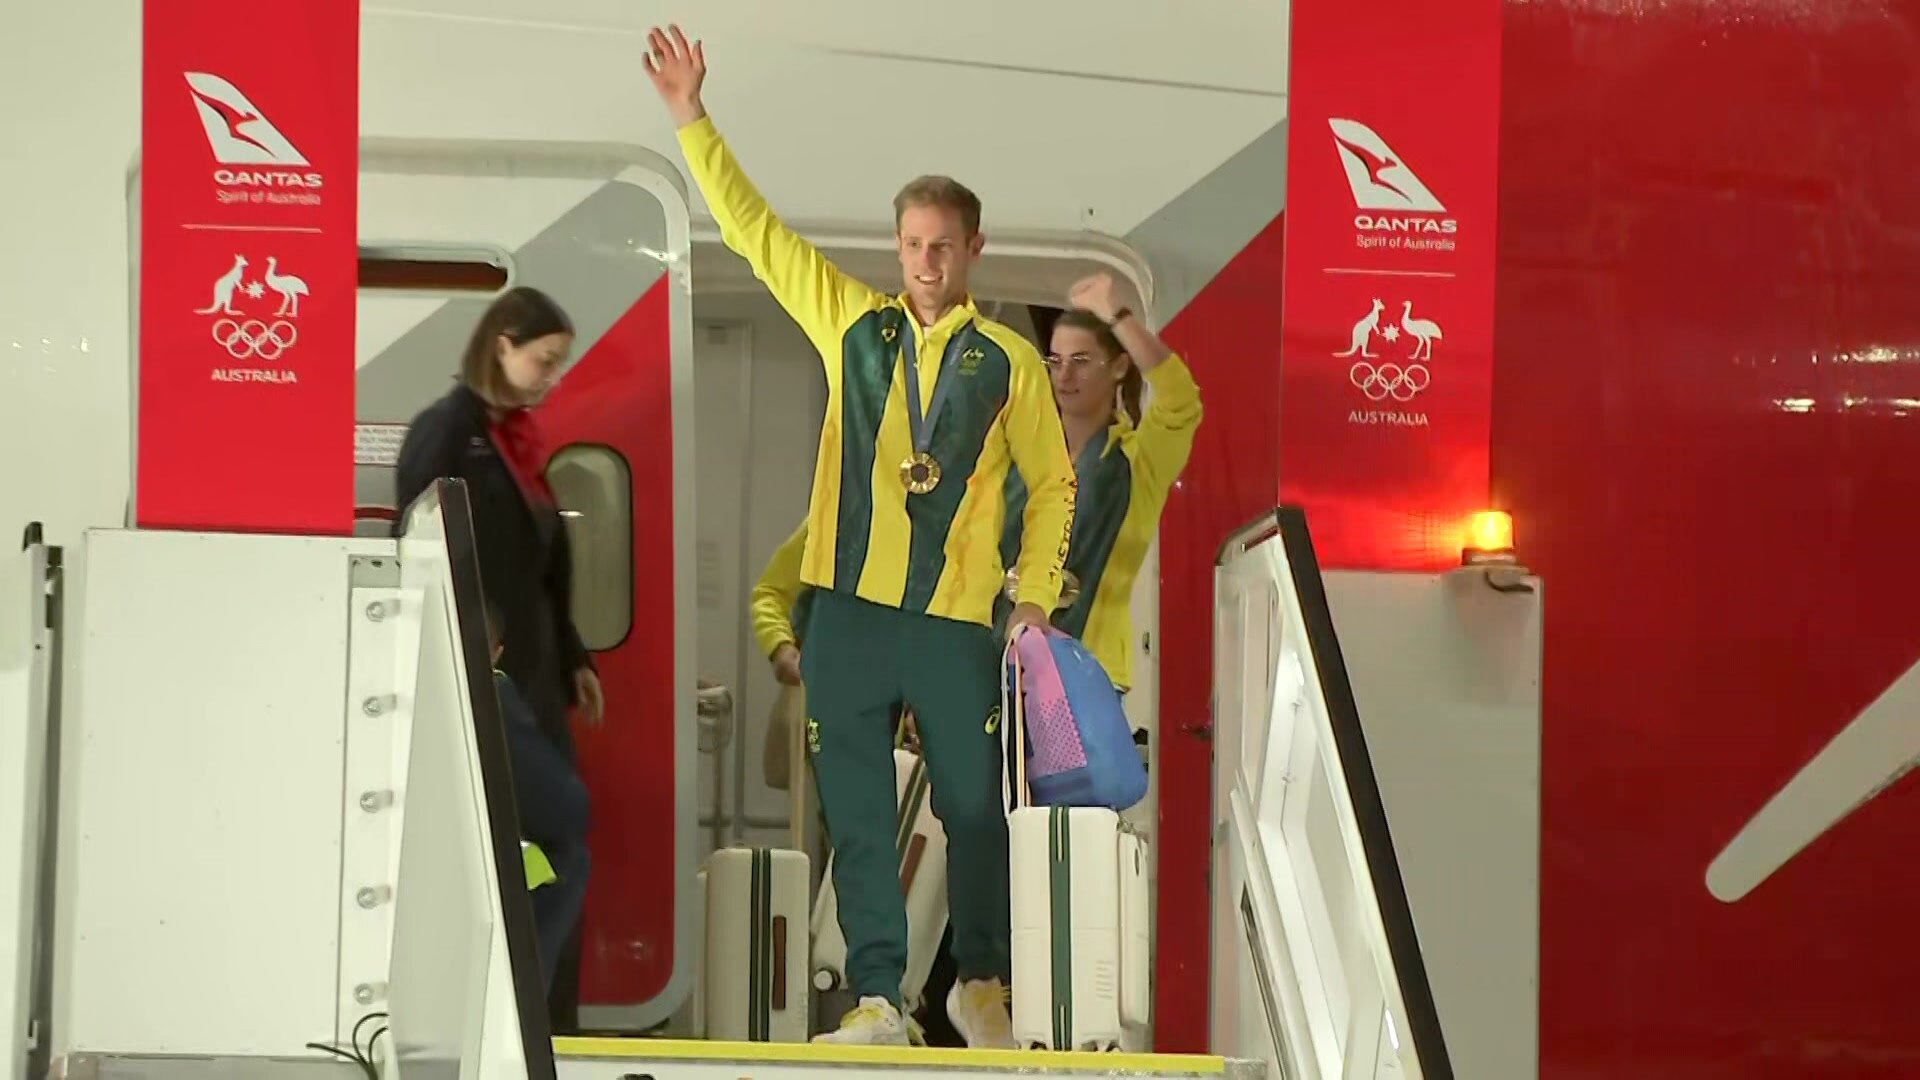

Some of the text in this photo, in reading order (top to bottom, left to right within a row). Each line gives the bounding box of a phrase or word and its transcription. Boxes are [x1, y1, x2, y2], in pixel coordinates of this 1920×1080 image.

[214, 170, 323, 187] QANTAS
[1354, 215, 1457, 233] QANTAS
[1357, 235, 1456, 251] Spirit of Australia
[211, 368, 297, 383] AUSTRALIA
[1348, 410, 1428, 426] AUSTRALIA
